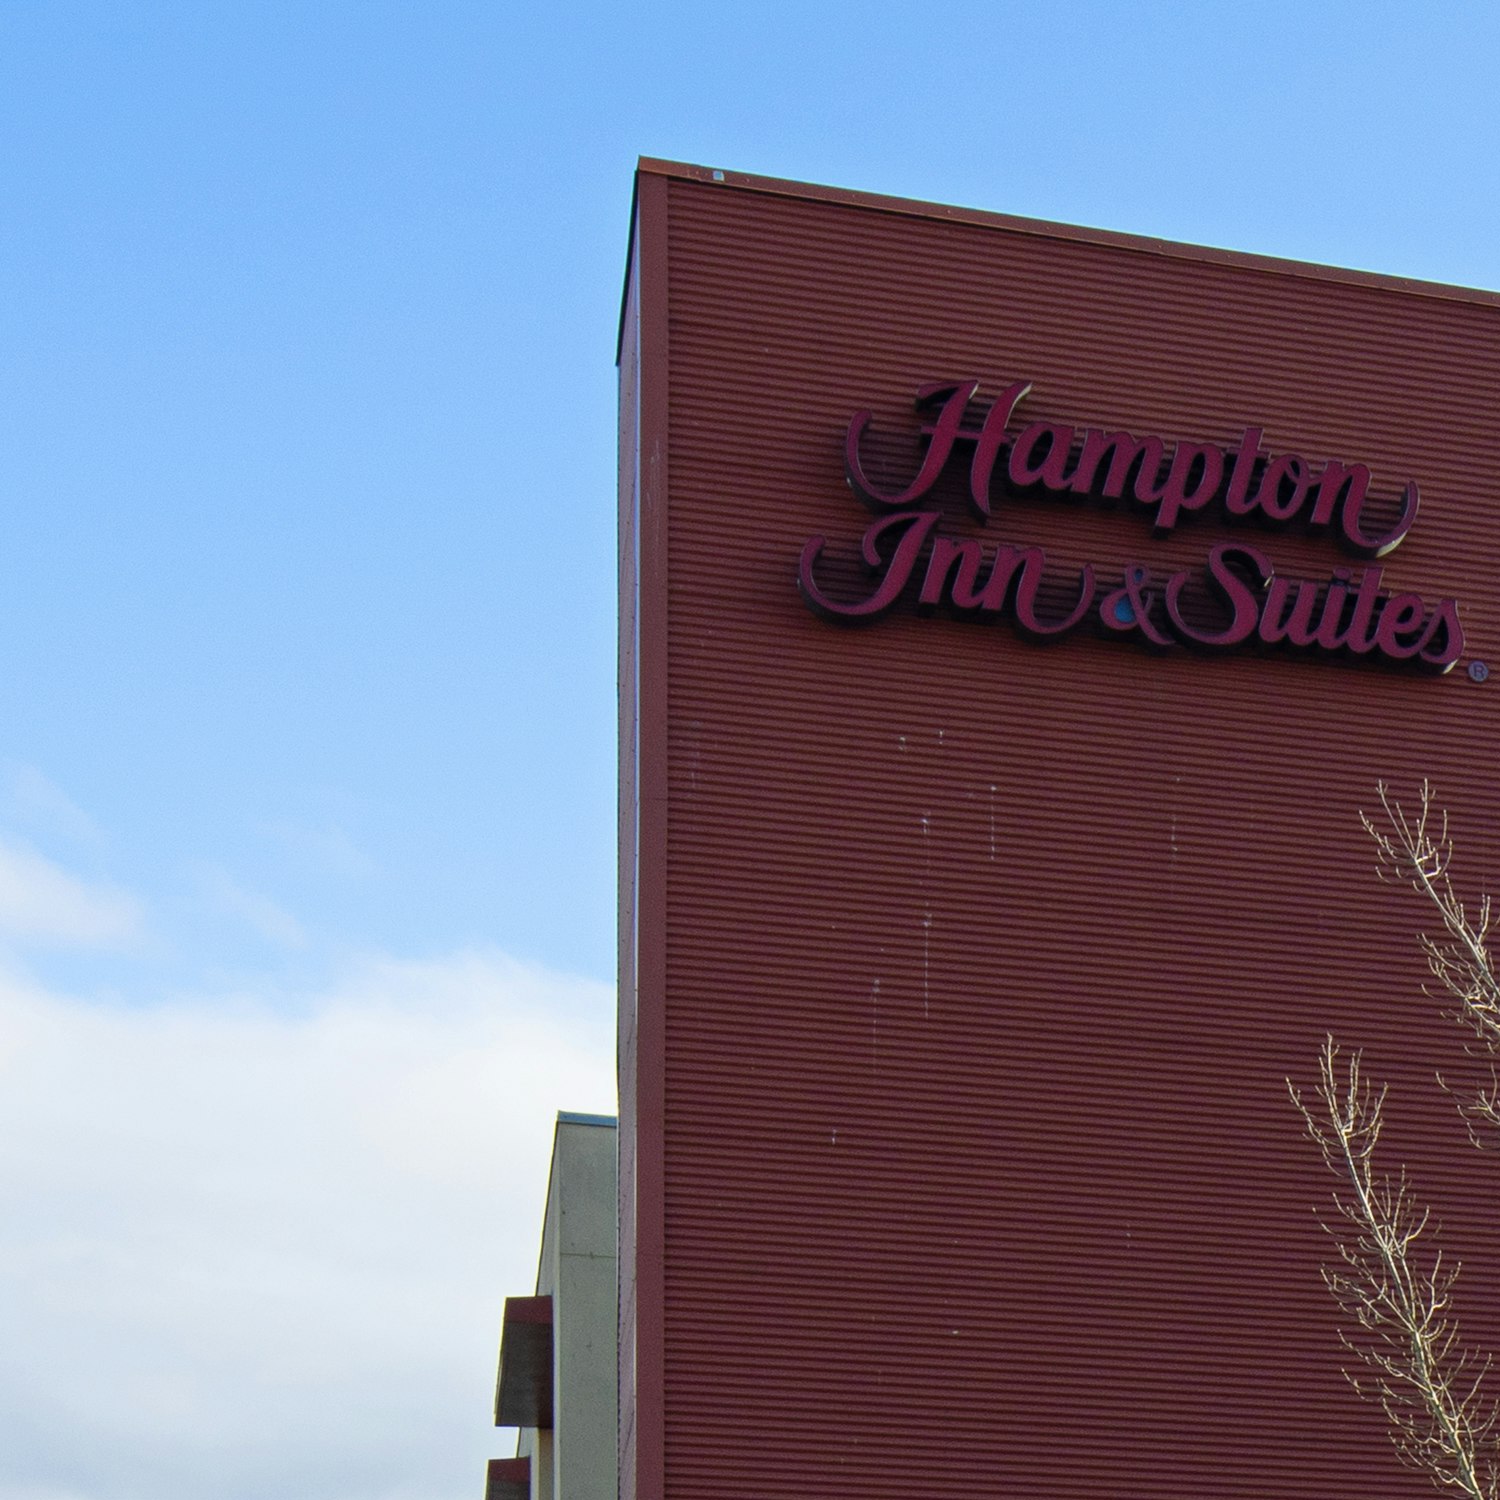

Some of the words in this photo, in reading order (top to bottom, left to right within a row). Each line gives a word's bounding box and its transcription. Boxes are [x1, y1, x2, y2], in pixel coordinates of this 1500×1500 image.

[843, 379, 1420, 559] Hampton
[798, 512, 1096, 638] Inn
[1100, 563, 1181, 648] &
[1166, 543, 1466, 675] Suites
